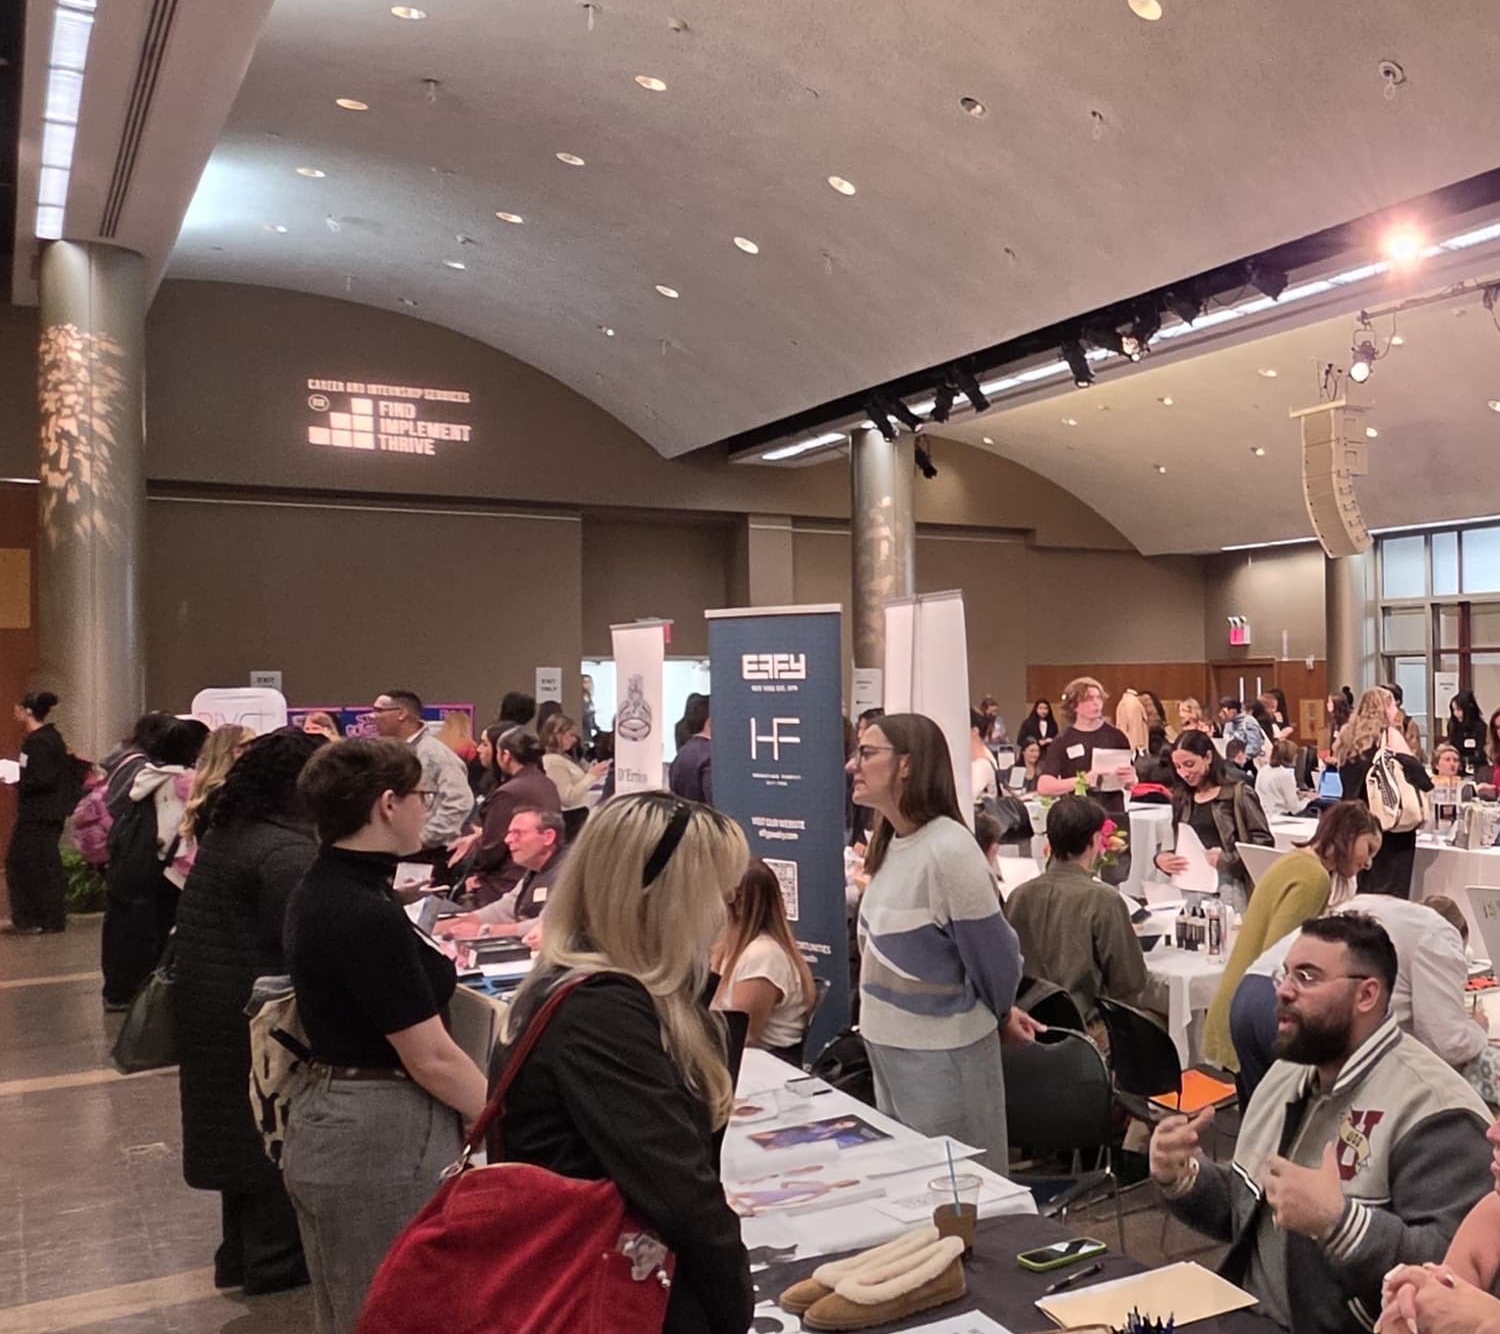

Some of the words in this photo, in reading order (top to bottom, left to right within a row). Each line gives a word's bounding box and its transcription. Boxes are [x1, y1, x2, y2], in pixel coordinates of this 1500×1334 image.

[379, 401, 416, 419] FIND
[380, 418, 471, 442] IMPLEMENT
[379, 435, 435, 456] THRIVE
[742, 653, 806, 680] EFFY
